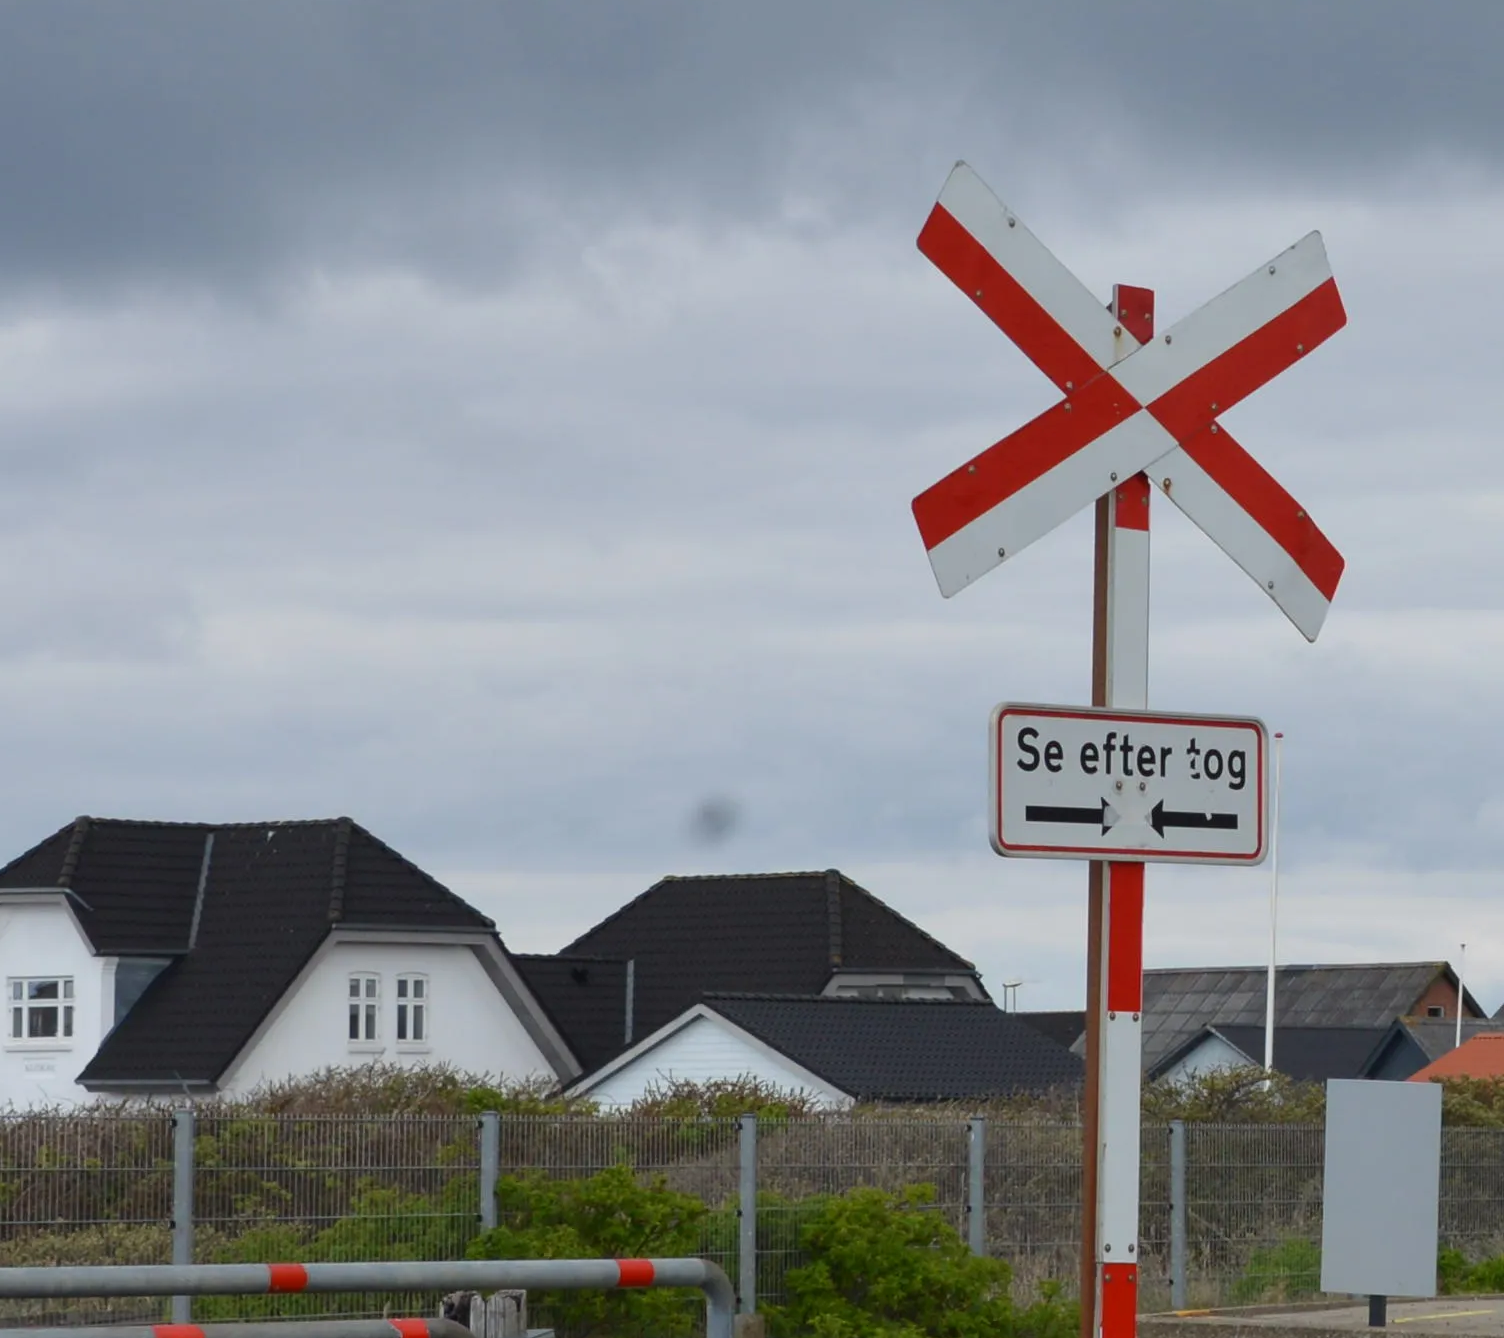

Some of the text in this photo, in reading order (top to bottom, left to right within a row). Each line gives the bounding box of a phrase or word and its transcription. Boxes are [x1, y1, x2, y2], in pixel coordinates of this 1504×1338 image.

[1016, 727, 1246, 790] Se efter tog
